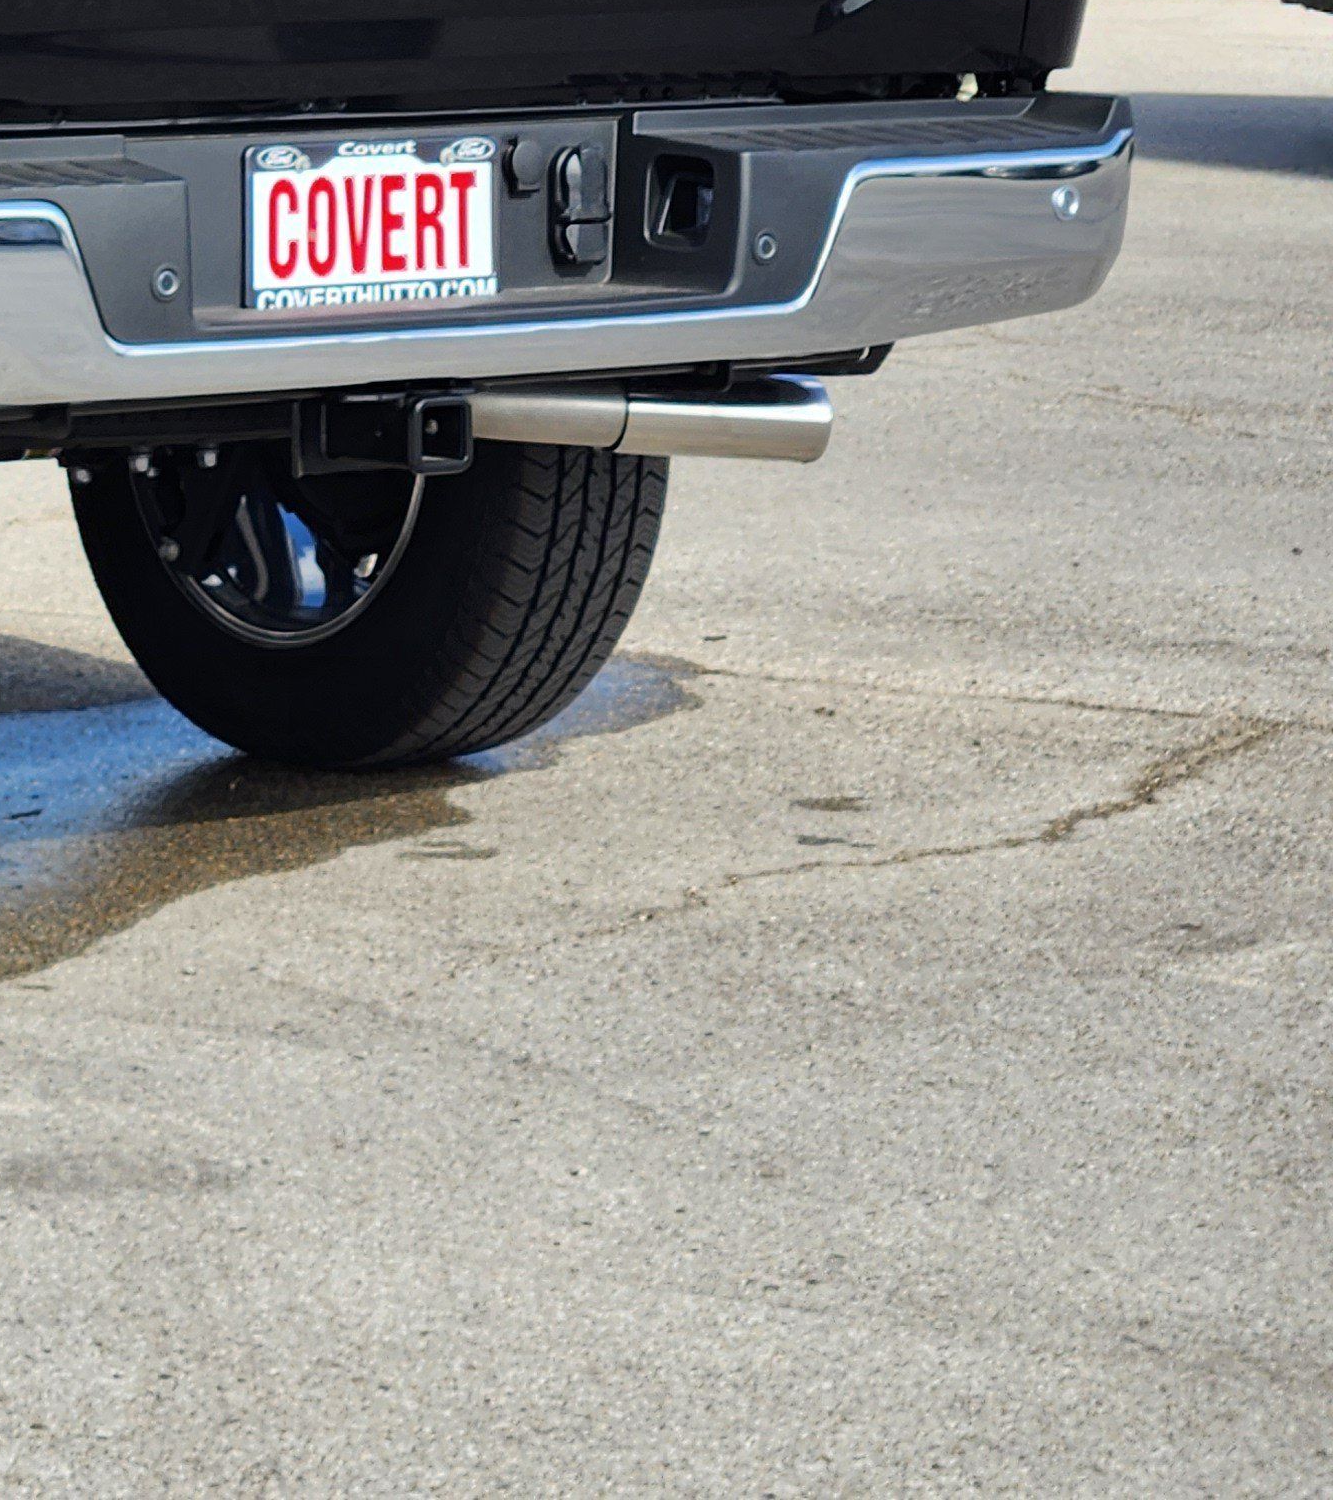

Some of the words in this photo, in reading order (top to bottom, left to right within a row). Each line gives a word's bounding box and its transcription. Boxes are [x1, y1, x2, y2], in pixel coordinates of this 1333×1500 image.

[337, 140, 417, 156] Covert
[268, 171, 478, 280] COVERT
[256, 277, 498, 311] COVERTHUTTOCOM
